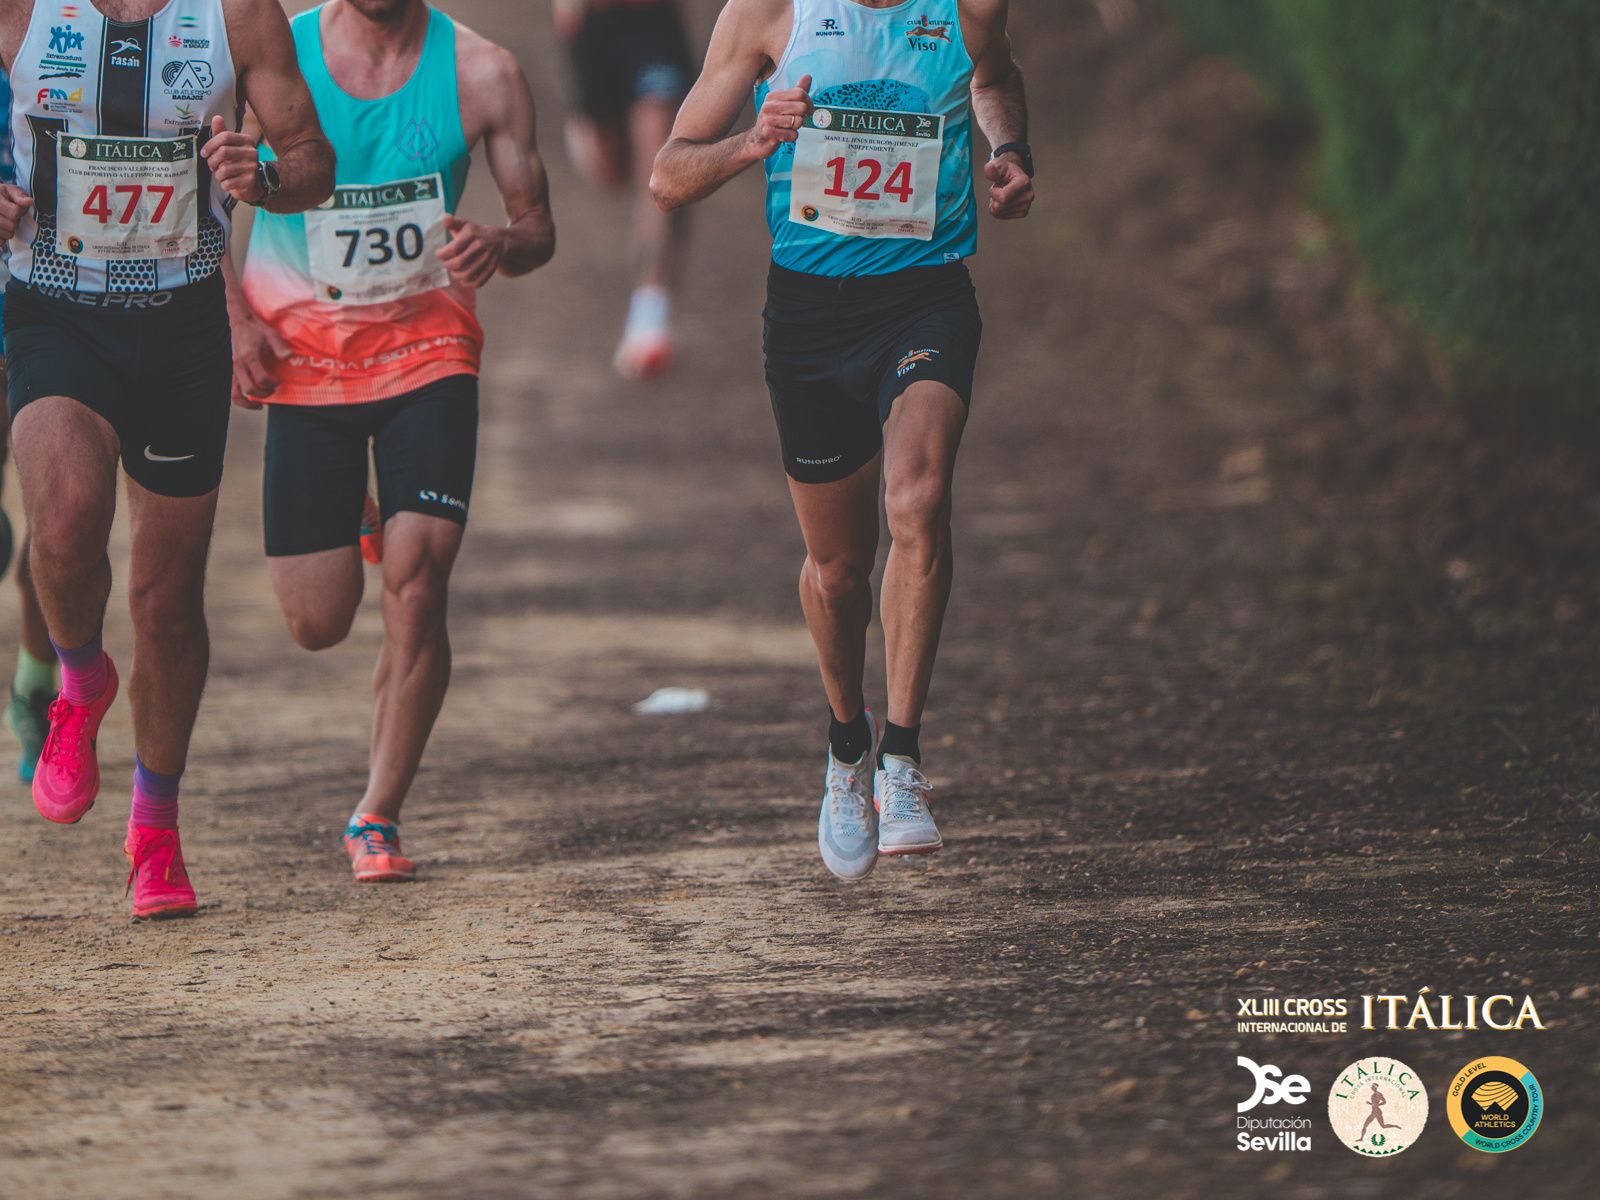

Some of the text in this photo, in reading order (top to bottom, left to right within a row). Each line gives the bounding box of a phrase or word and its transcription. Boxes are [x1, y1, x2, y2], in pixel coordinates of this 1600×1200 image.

[907, 37, 937, 52] Viso
[848, 143, 895, 153] INDEPENDIENTE
[824, 156, 914, 203] 124
[82, 184, 175, 224] 477
[335, 223, 424, 268] 730
[102, 291, 173, 308] PRO
